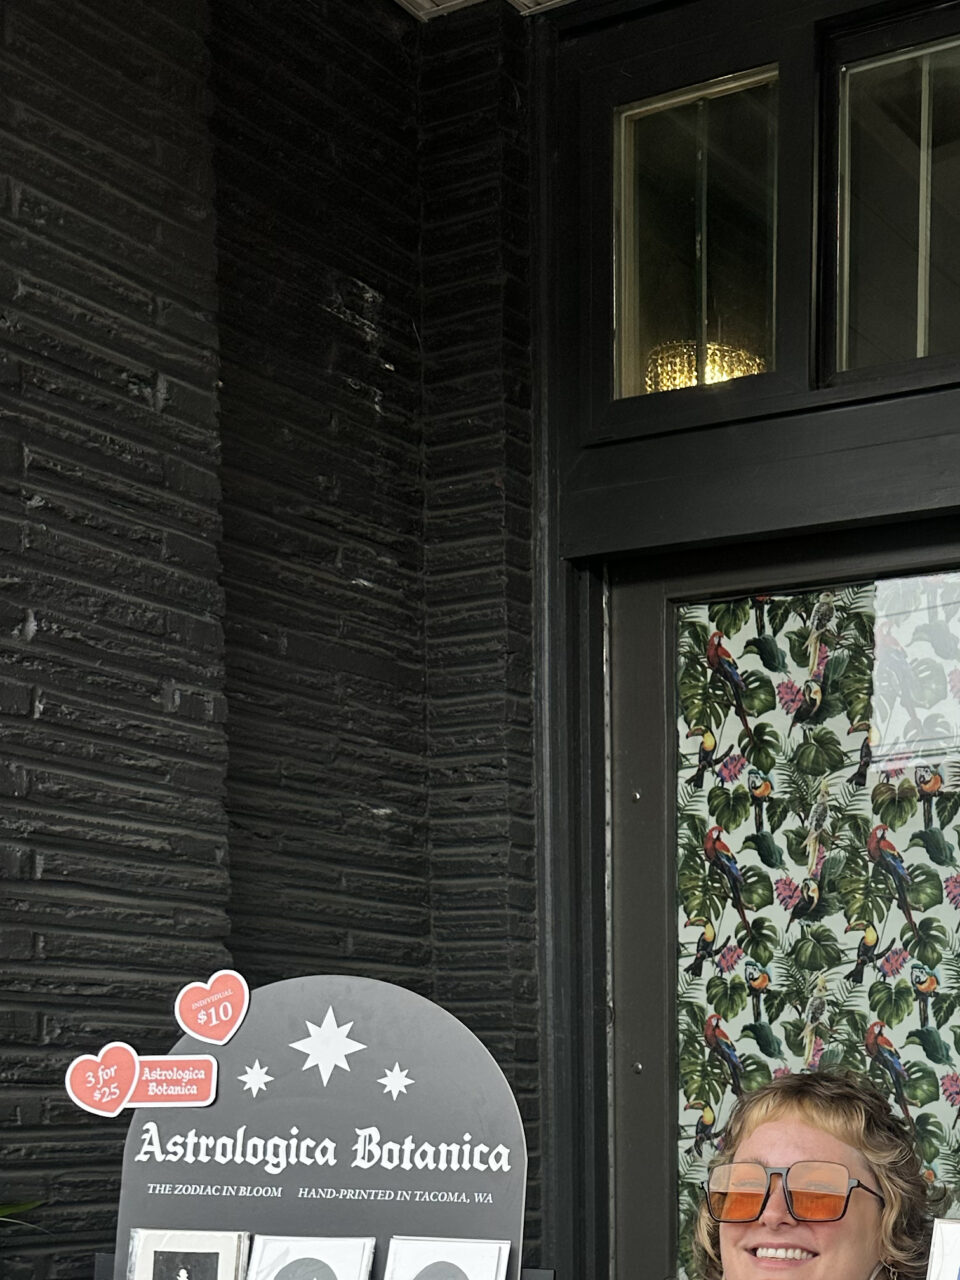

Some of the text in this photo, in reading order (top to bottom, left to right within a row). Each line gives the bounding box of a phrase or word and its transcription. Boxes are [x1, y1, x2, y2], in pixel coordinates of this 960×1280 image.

[192, 989, 233, 1010] INDIVIDUAL
[197, 1001, 232, 1027] $10
[85, 1064, 117, 1088] 3 for
[141, 1067, 205, 1082] Astrologica
[93, 1082, 120, 1103] $25
[148, 1082, 198, 1096] Botanica
[134, 1121, 512, 1175] Astrologica Botanica
[147, 1183, 493, 1204] THE ZODIAC IN BLOOM HAND-PRINTED IN TACOMA, WA
